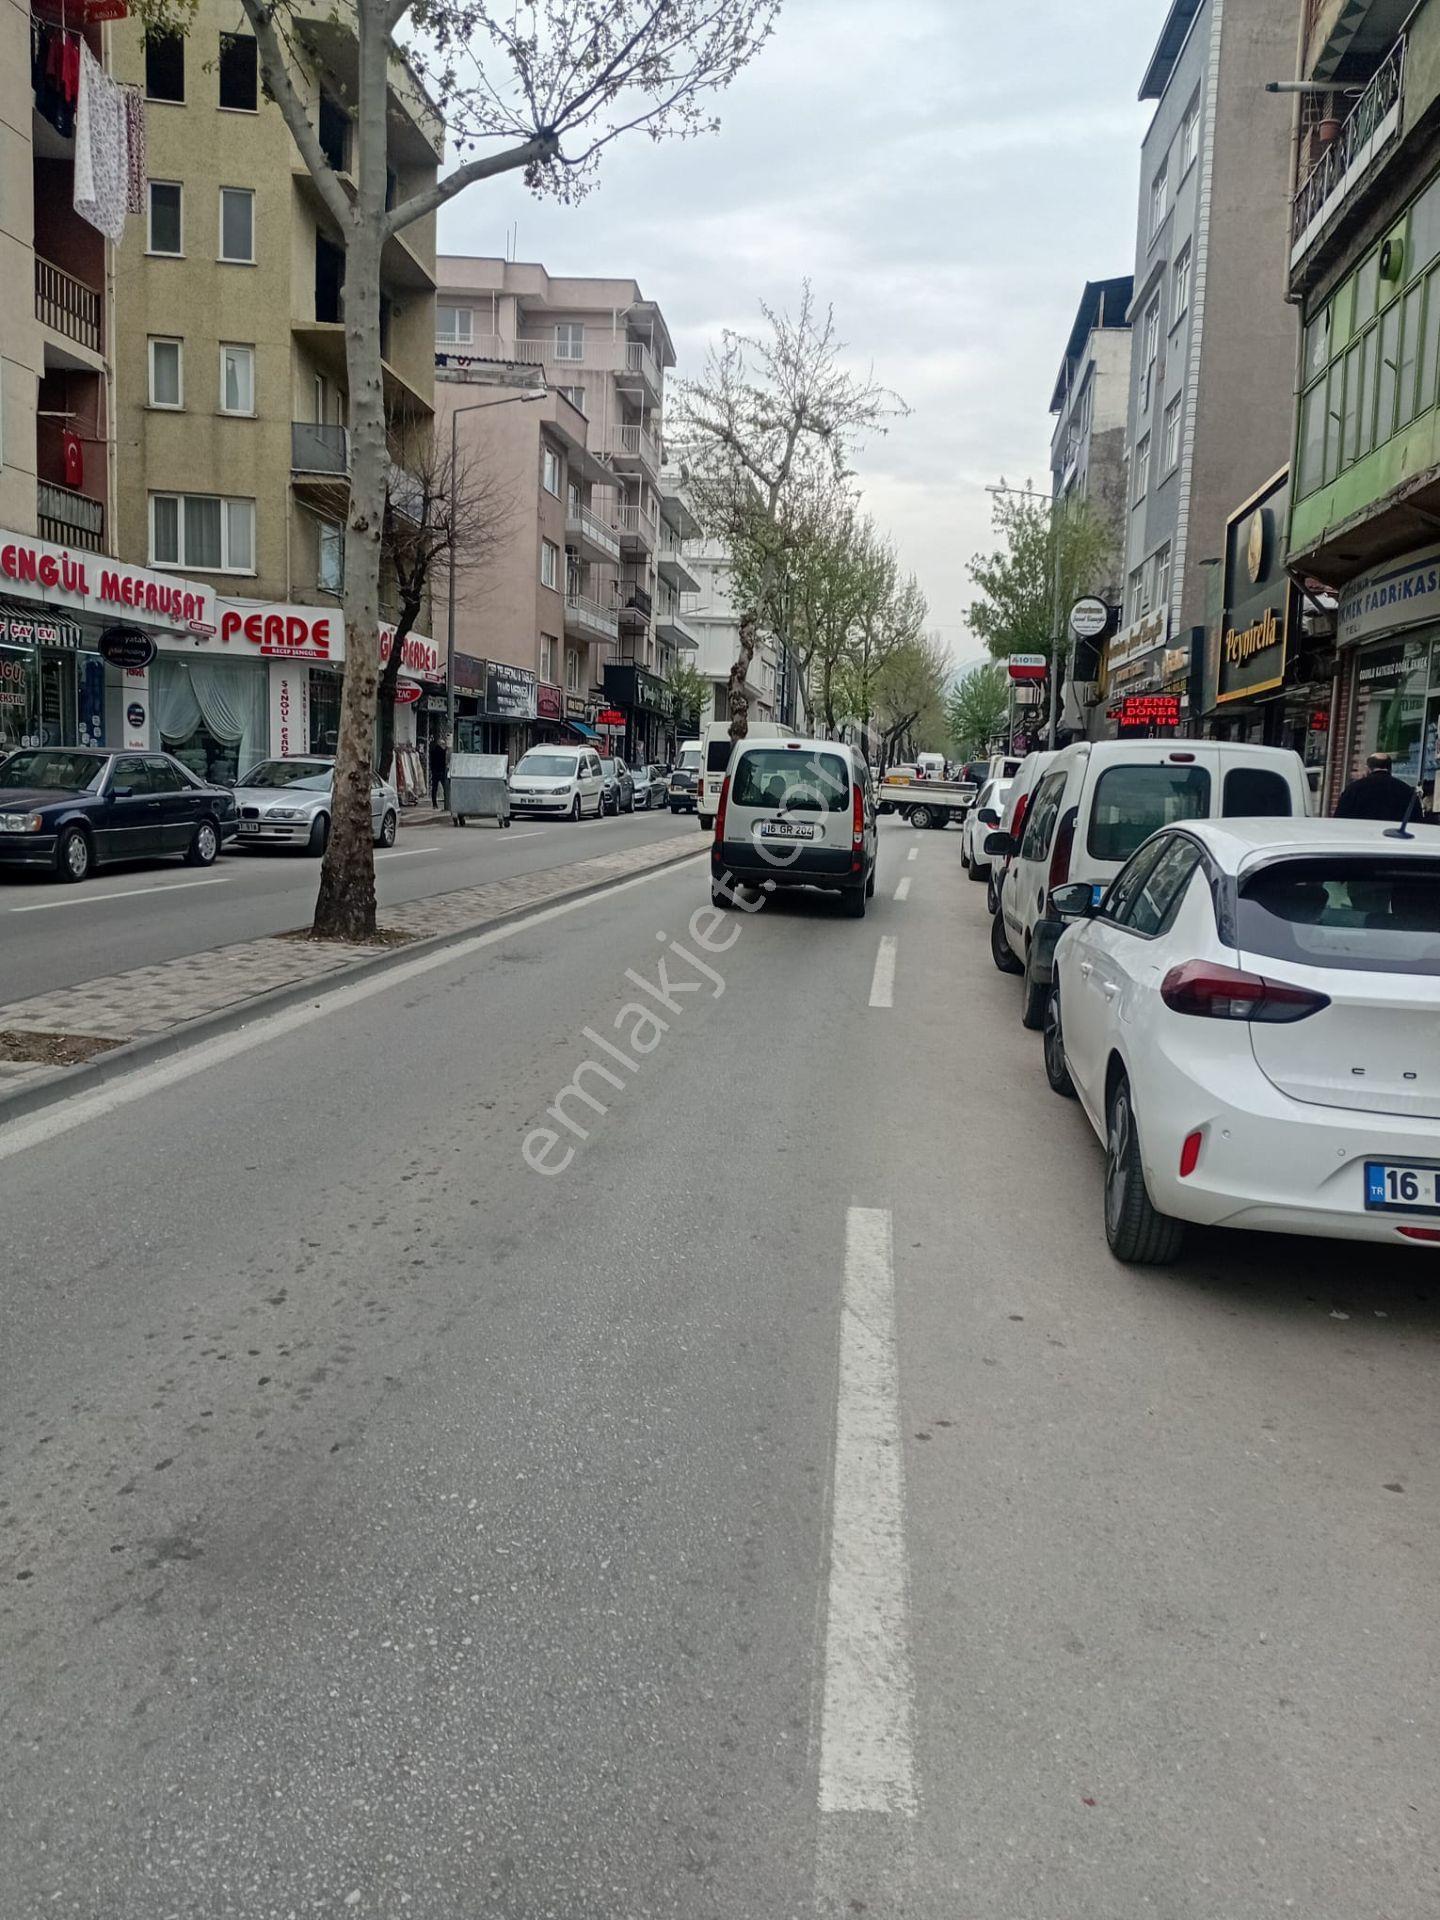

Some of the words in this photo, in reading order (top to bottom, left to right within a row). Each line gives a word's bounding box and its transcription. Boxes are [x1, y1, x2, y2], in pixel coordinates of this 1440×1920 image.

[101, 571, 205, 621] MEFRUŞAT
[11, 625, 32, 637] ÇAY
[222, 612, 329, 647] PERDE
[1226, 607, 1276, 668] Peynirella
[1127, 706, 1177, 715] DÖNER
[767, 824, 775, 833] 16
[780, 825, 792, 834] GR
[1371, 1185, 1384, 1195] TR
[1387, 1170, 1419, 1201] 16
